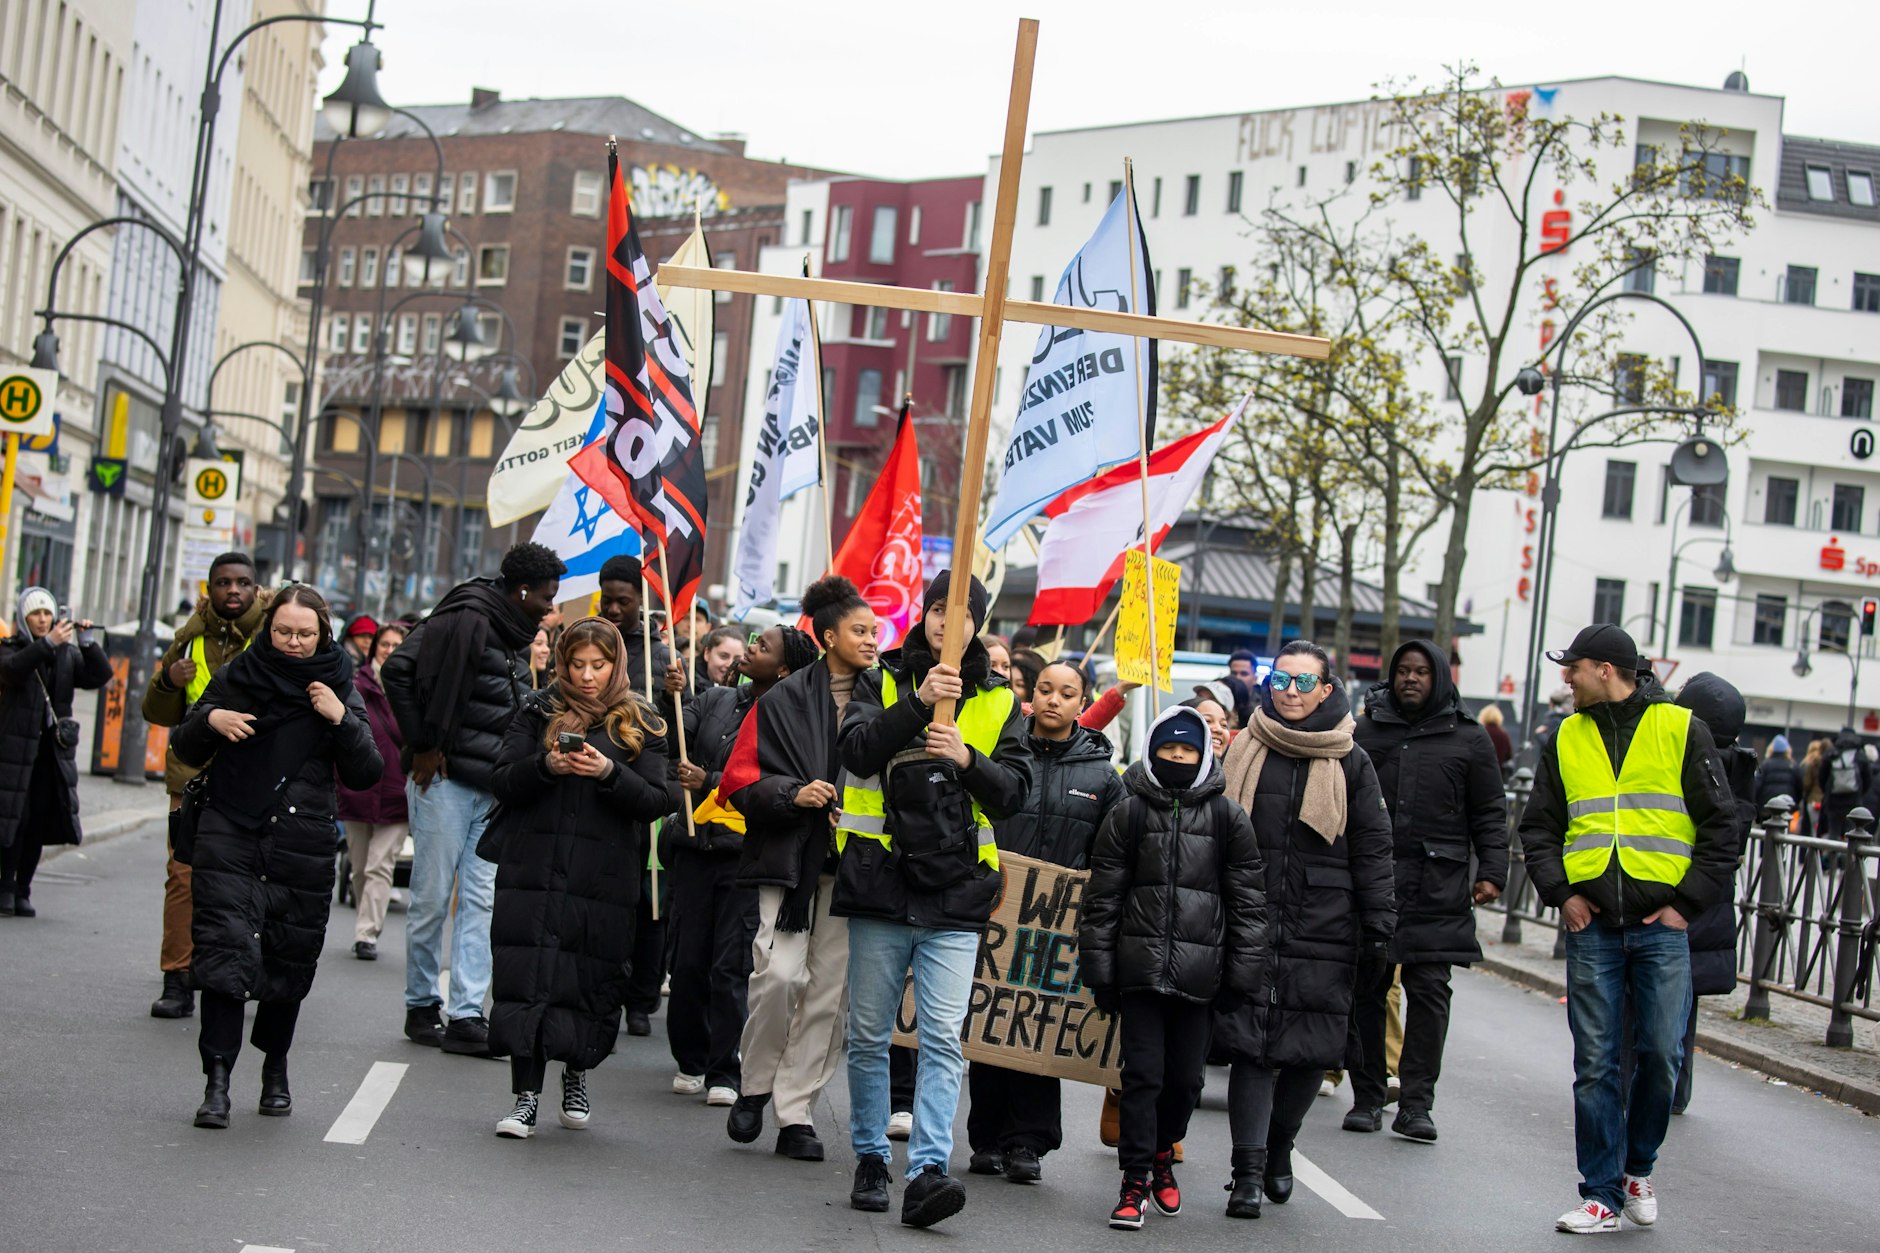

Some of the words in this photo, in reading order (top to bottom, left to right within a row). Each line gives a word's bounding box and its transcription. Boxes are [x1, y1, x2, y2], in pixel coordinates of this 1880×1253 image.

[6, 385, 30, 413] H
[204, 475, 220, 492] H
[1855, 556, 1880, 579] Sp
[1018, 867, 1088, 931] WA
